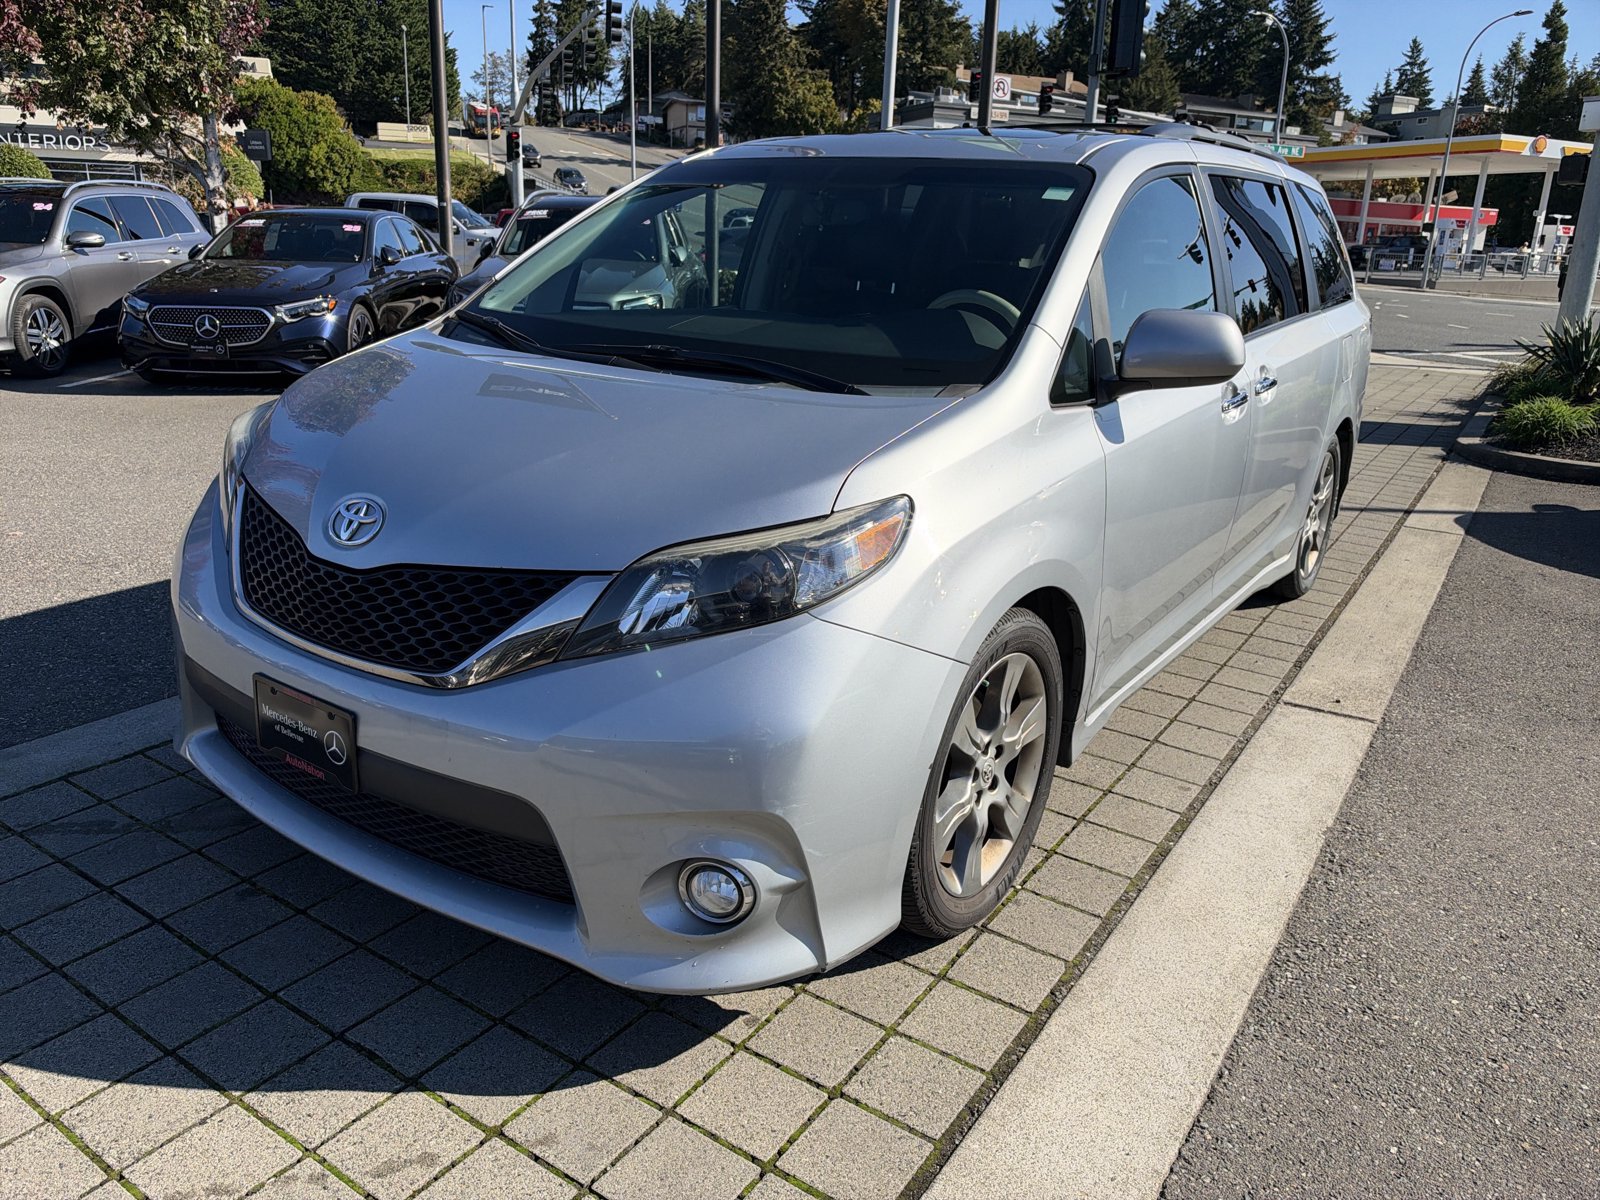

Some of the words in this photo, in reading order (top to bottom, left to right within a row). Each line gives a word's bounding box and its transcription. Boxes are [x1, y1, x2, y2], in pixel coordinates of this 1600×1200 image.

[262, 703, 318, 739] Mercedes-Benz
[281, 725, 304, 743] Bellevue
[286, 754, 325, 780] AutoNation
